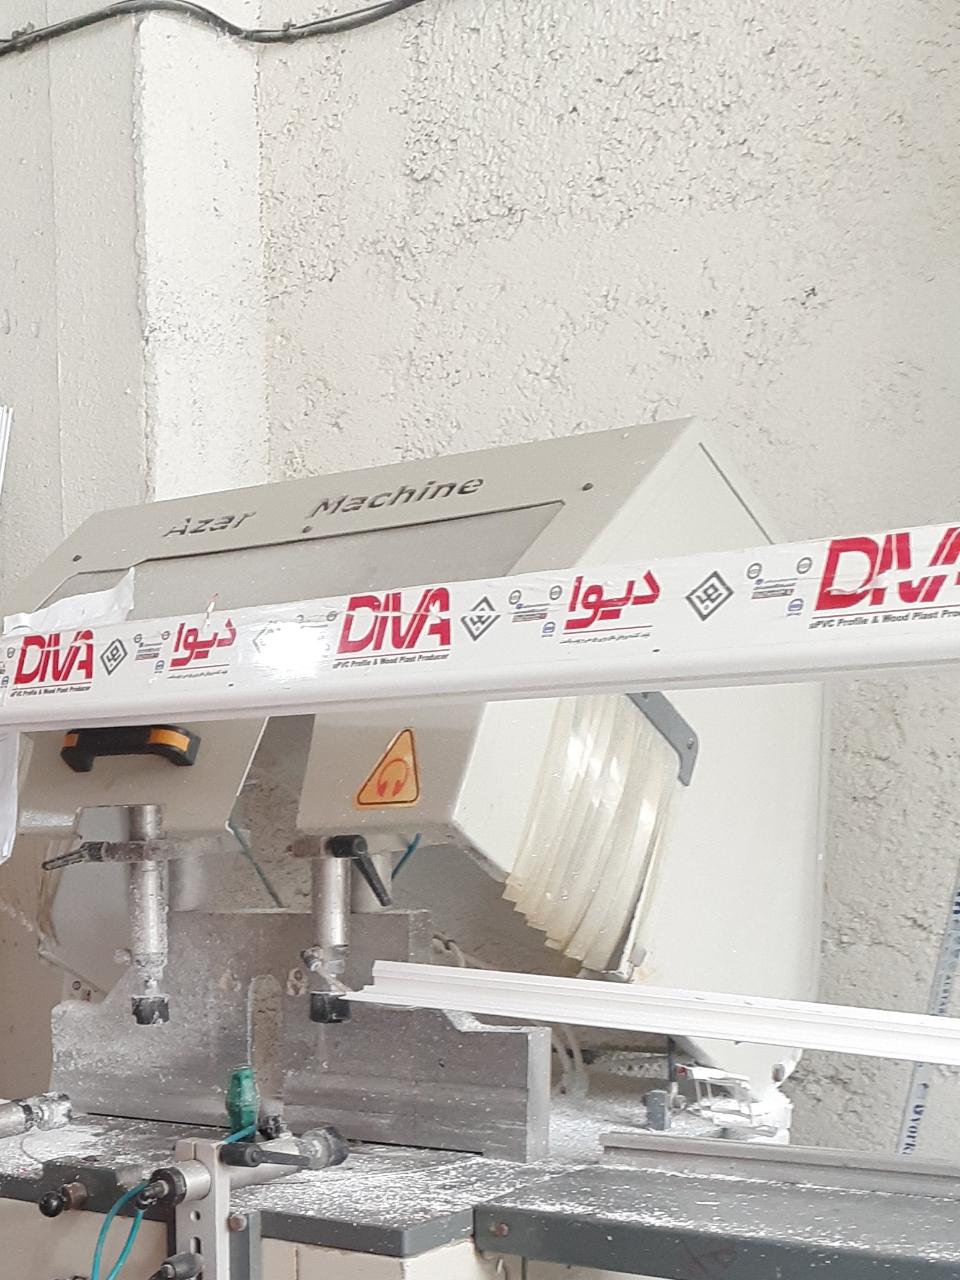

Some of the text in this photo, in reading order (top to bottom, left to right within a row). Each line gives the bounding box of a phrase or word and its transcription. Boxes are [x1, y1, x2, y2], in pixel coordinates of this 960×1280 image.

[161, 478, 484, 537] Azar Machine
[336, 586, 452, 655] DIVA
[13, 629, 95, 685] DIVA
